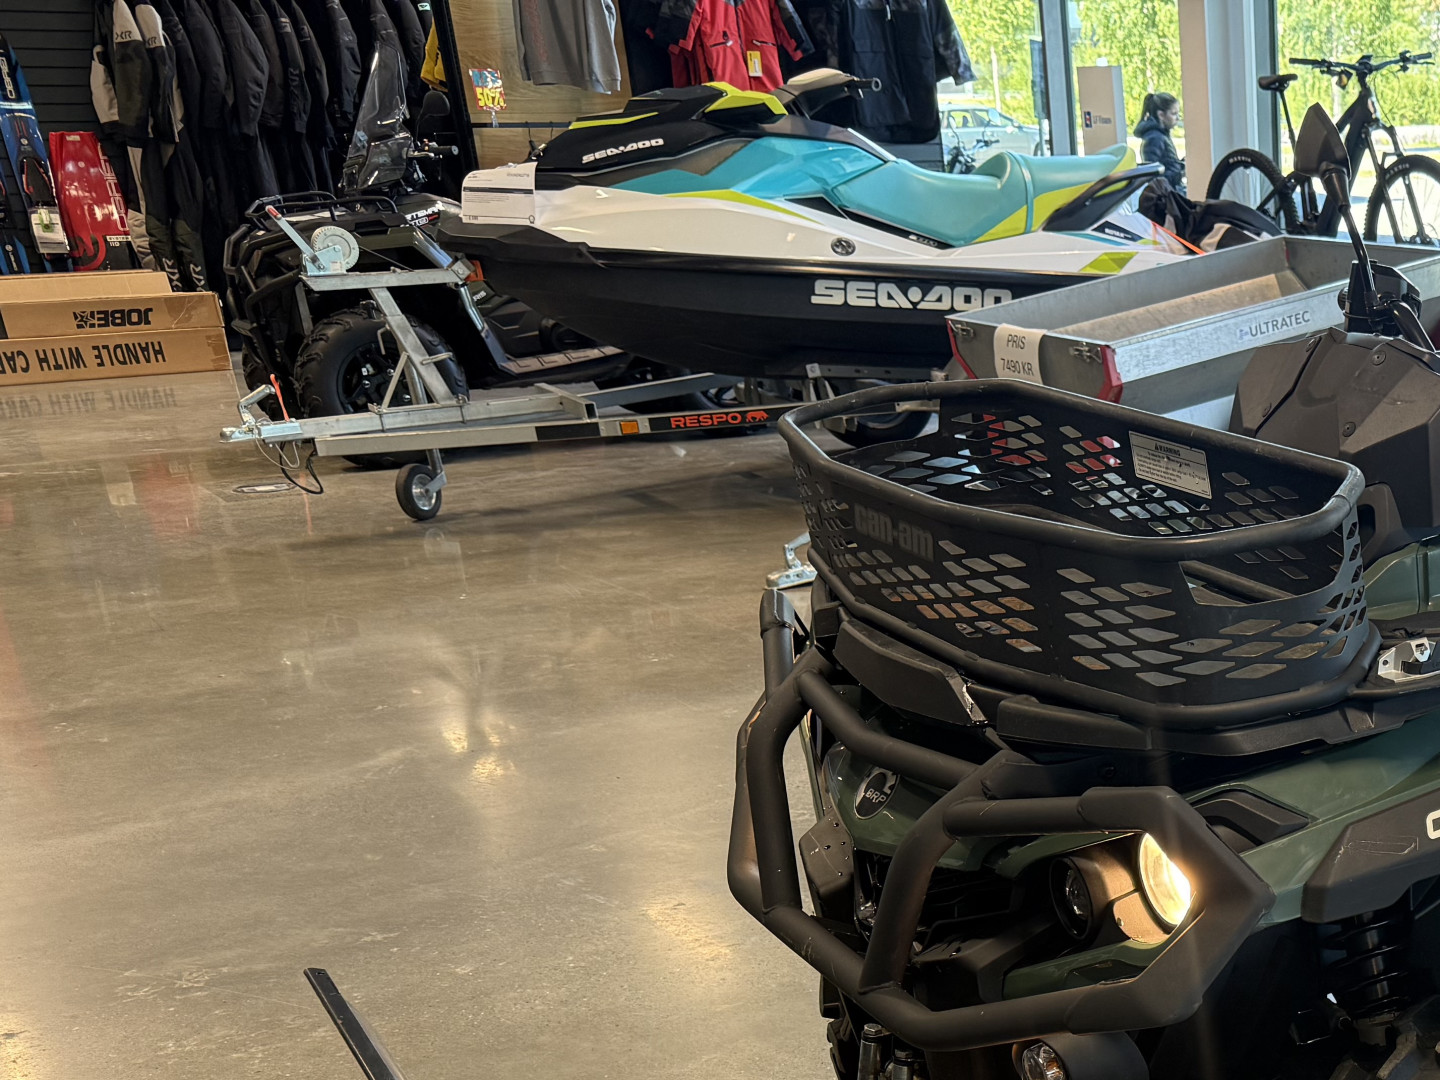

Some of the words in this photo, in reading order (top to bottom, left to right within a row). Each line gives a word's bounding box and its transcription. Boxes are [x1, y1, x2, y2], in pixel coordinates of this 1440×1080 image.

[1249, 310, 1311, 338] ULTRATEC
[1006, 333, 1026, 350] PRIS
[35, 346, 88, 372] WITH
[92, 341, 167, 368] HANDLE
[1000, 358, 1021, 374] 7490
[1021, 362, 1035, 377] KR
[670, 412, 742, 429] RESPO
[865, 788, 887, 803] BRP
